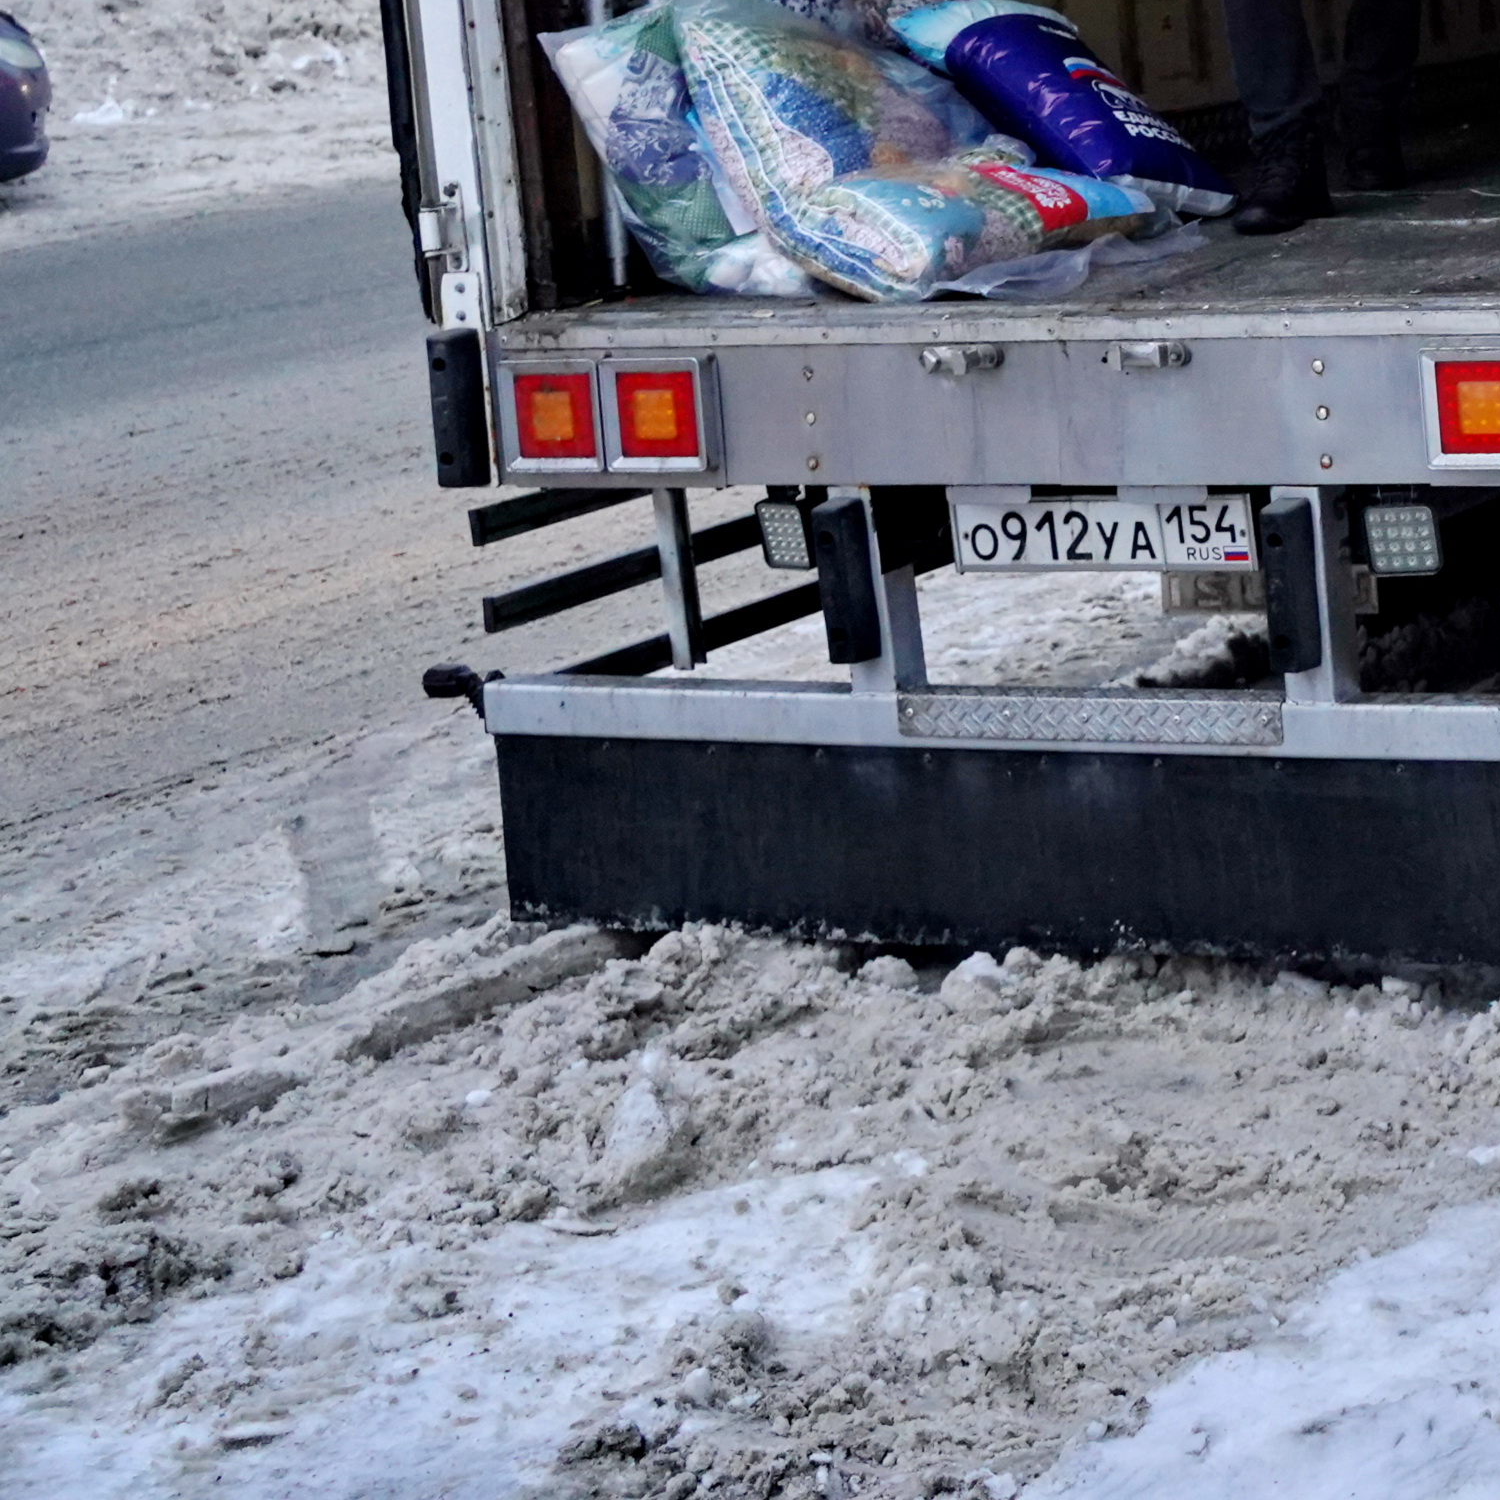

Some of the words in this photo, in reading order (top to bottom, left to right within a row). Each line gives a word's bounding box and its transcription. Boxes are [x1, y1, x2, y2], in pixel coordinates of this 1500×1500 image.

[970, 511, 1156, 561] О912УА
[1165, 504, 1237, 544] 154
[1187, 546, 1222, 561] RUS
